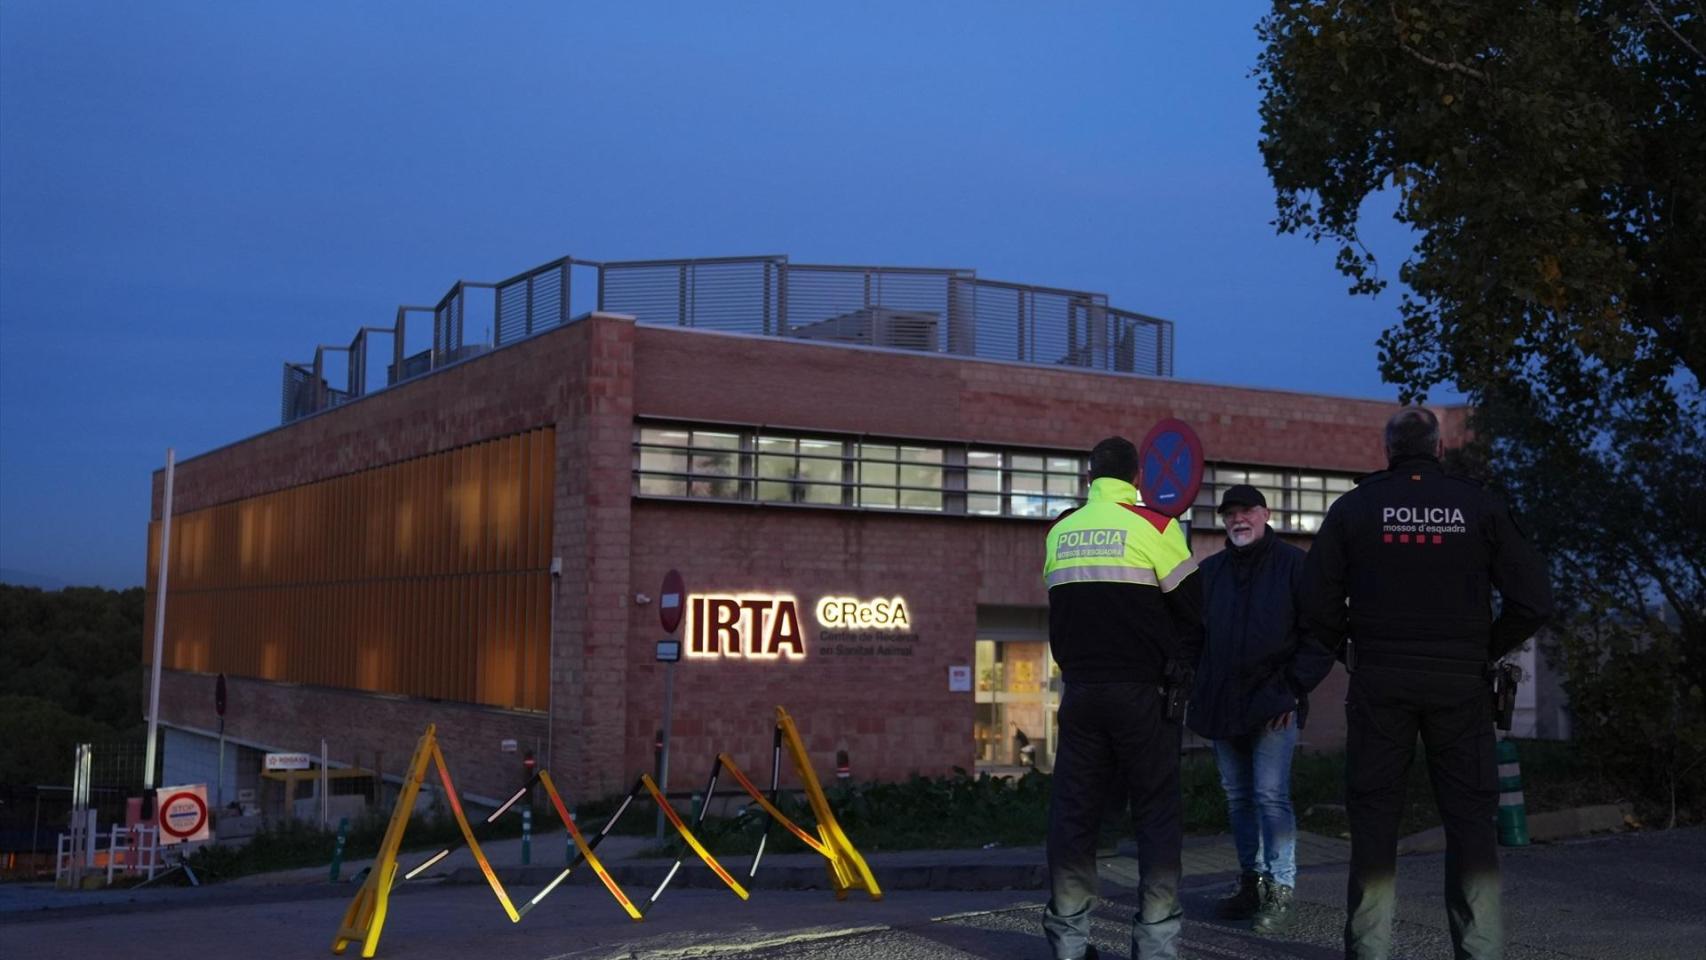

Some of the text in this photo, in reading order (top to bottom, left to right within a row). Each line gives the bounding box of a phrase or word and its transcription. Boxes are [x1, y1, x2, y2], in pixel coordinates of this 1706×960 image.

[1383, 507, 1465, 523] POLICIA
[1058, 531, 1122, 548] POLICIA
[819, 598, 910, 627] CReSA
[690, 597, 804, 655] IRTA
[859, 631, 872, 641] de
[819, 644, 912, 656] en Sanitat Animal
